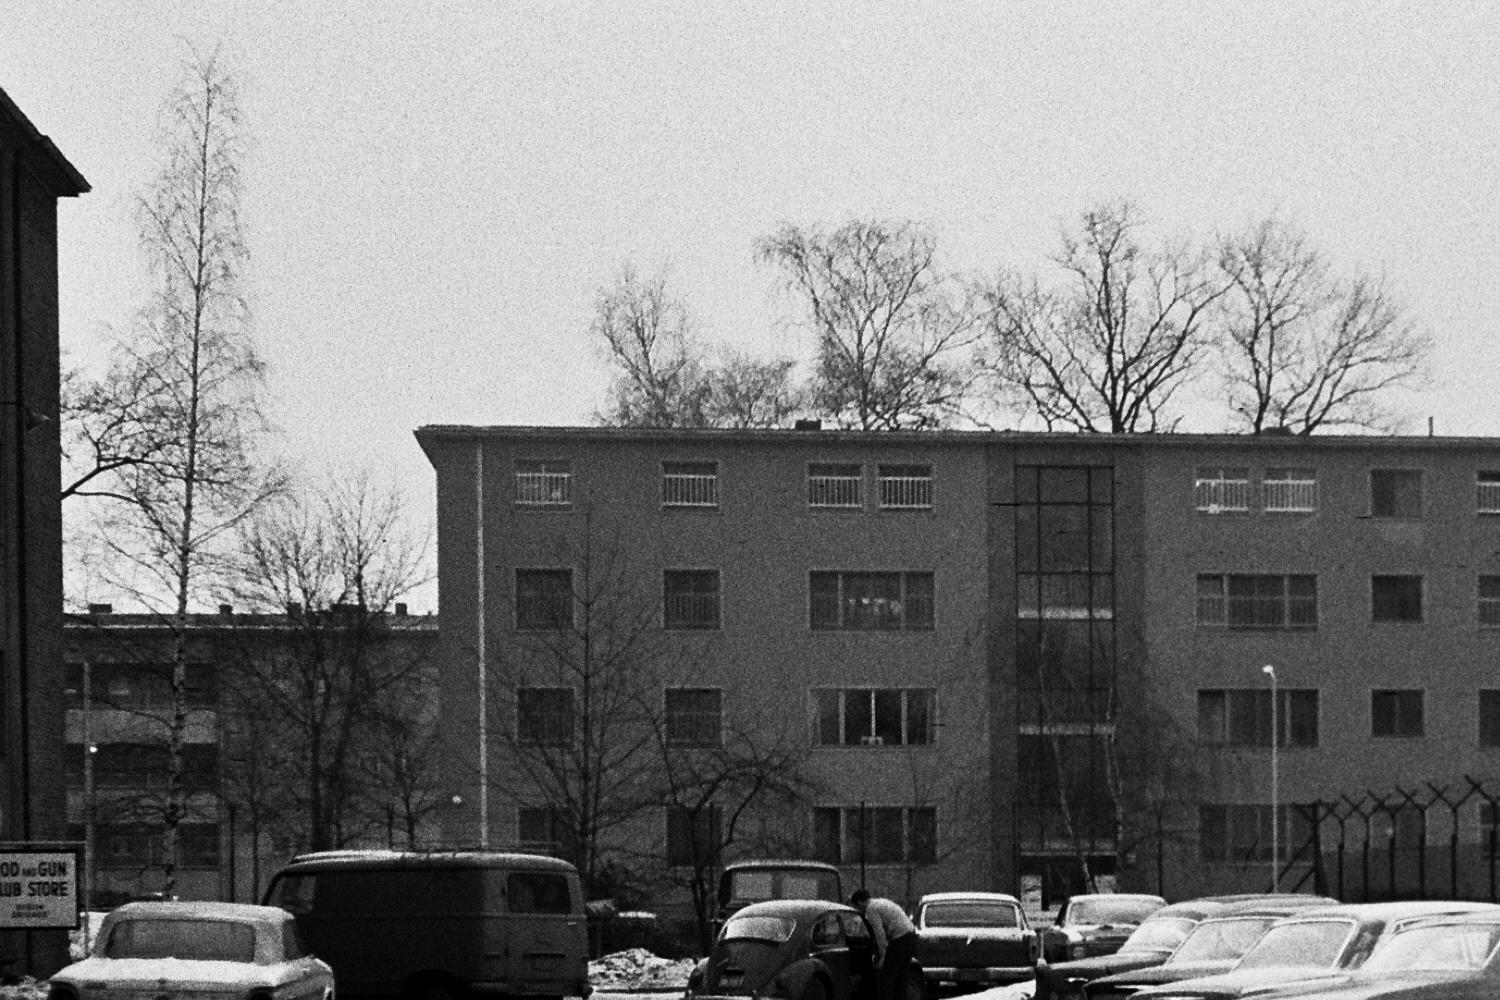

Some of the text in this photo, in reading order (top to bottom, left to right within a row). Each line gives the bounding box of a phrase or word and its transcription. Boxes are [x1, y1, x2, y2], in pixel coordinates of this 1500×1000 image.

[0, 861, 20, 877] OD
[39, 861, 67, 877] GUN
[28, 881, 69, 897] STORE
